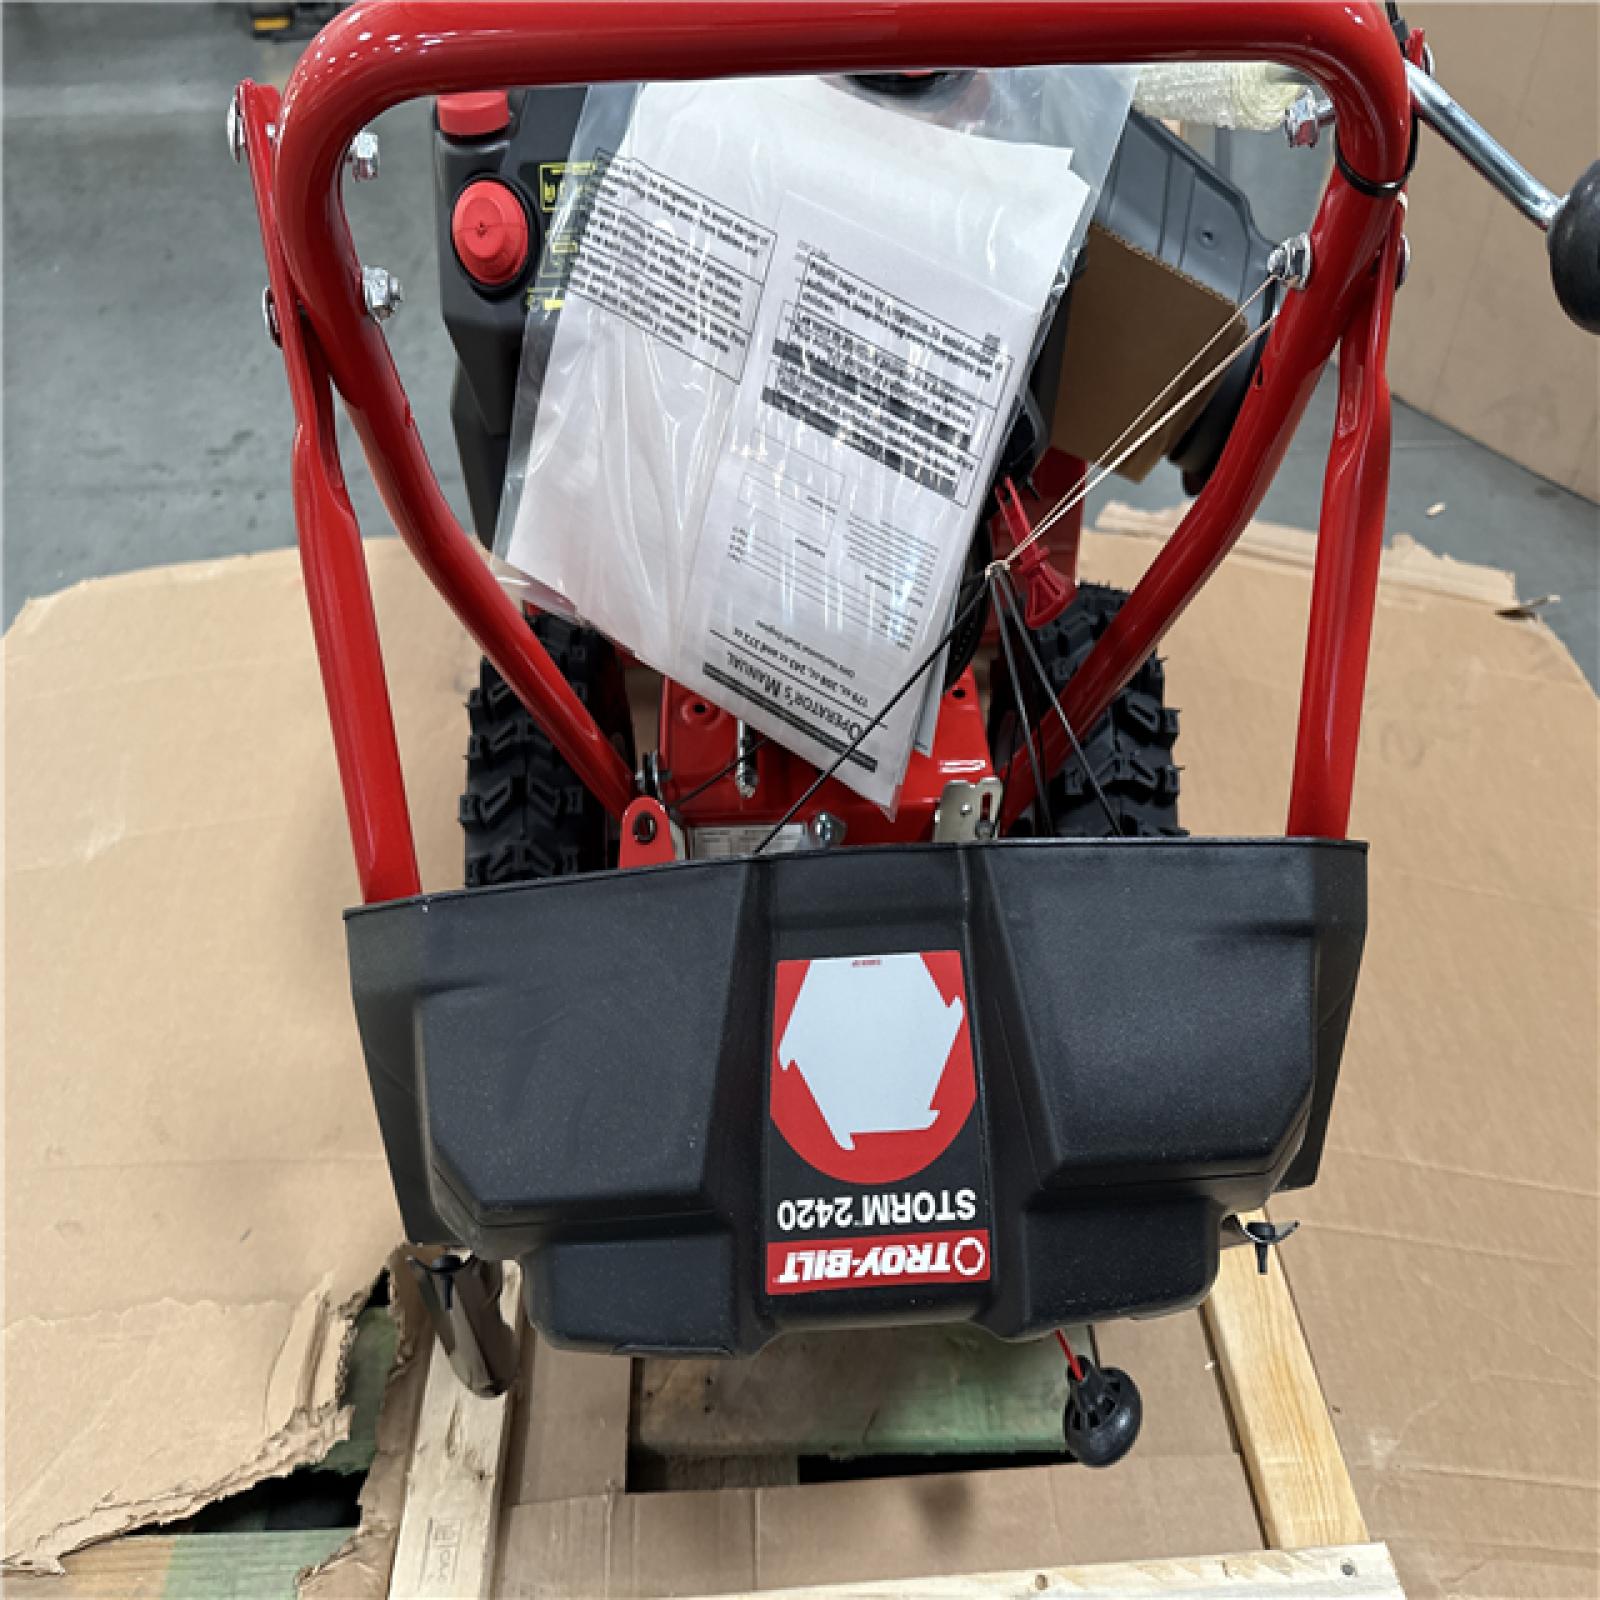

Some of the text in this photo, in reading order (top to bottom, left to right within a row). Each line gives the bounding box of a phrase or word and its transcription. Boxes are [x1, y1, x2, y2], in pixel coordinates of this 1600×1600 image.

[777, 1187, 976, 1231] STORM 2420
[777, 1241, 951, 1284] TROY-BILT
